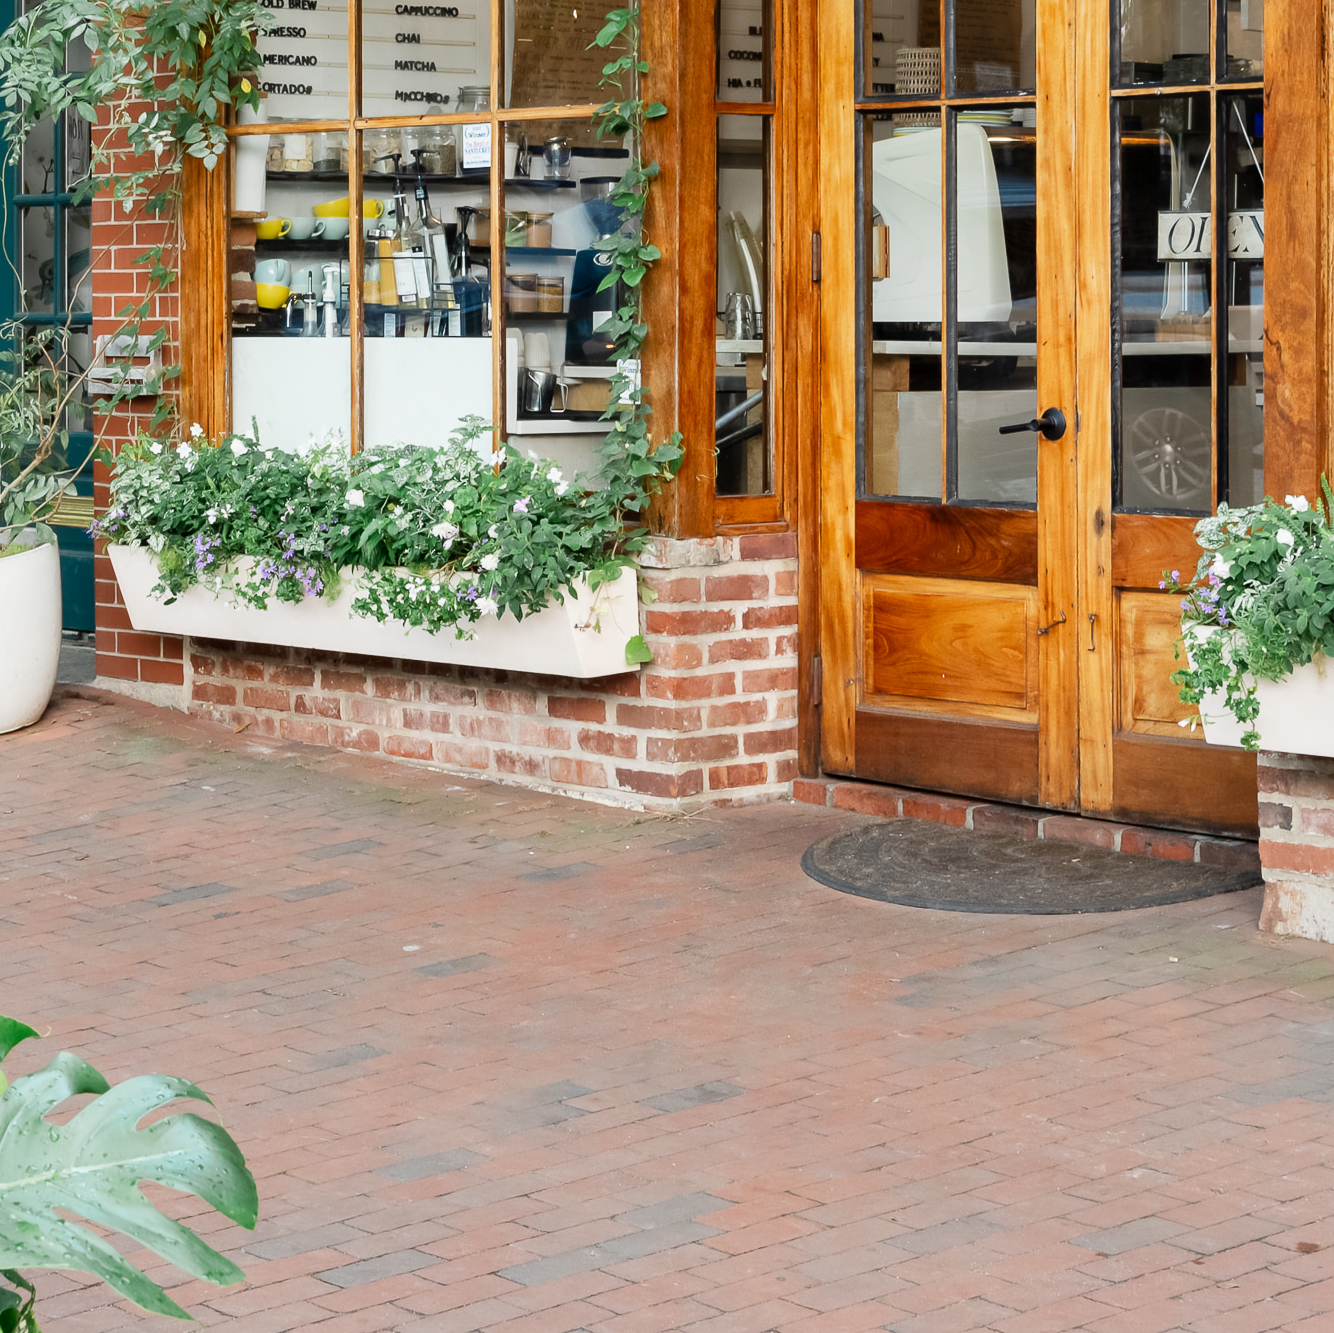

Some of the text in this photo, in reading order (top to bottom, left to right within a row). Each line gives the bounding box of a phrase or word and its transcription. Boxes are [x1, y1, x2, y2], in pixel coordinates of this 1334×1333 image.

[395, 4, 459, 17] CAPPUCCINO
[395, 33, 421, 44] CHAI
[395, 60, 437, 72] MATCHA
